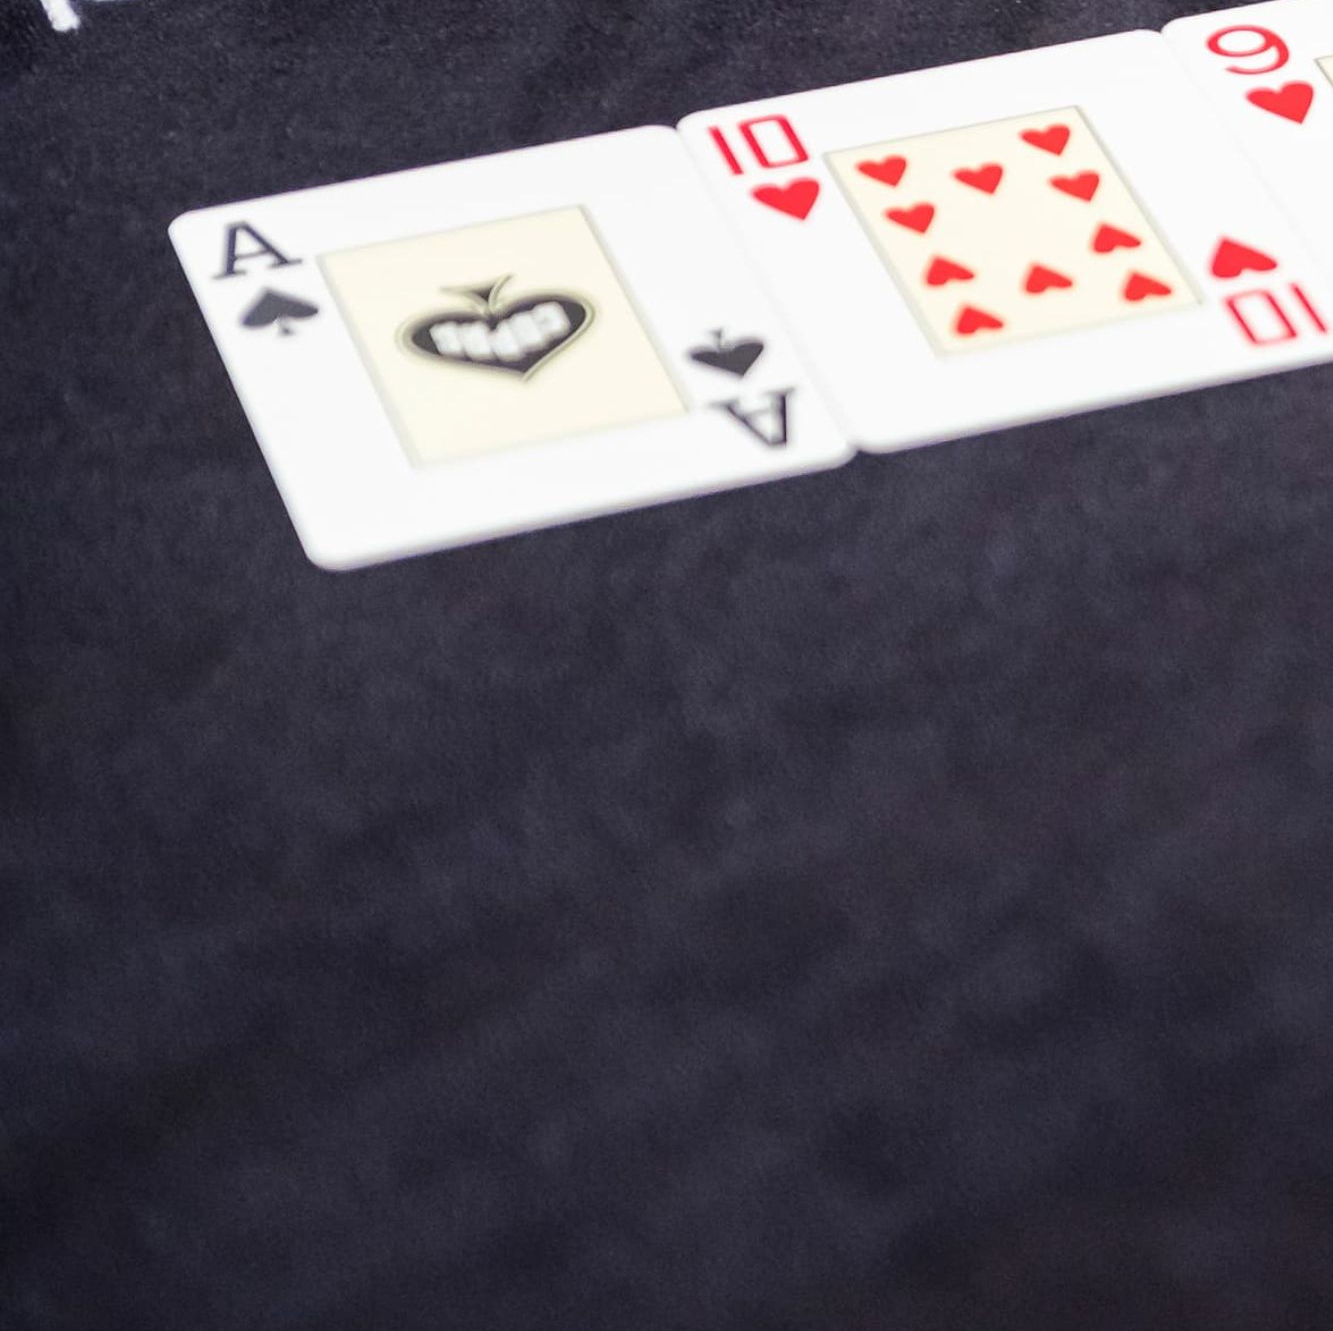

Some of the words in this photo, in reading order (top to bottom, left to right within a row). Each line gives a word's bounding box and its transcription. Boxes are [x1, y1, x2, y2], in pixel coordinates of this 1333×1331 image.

[1206, 25, 1290, 75] 9
[707, 115, 810, 176] 10
[213, 221, 304, 278] A
[1224, 283, 1330, 347] 10
[711, 387, 797, 449] A
